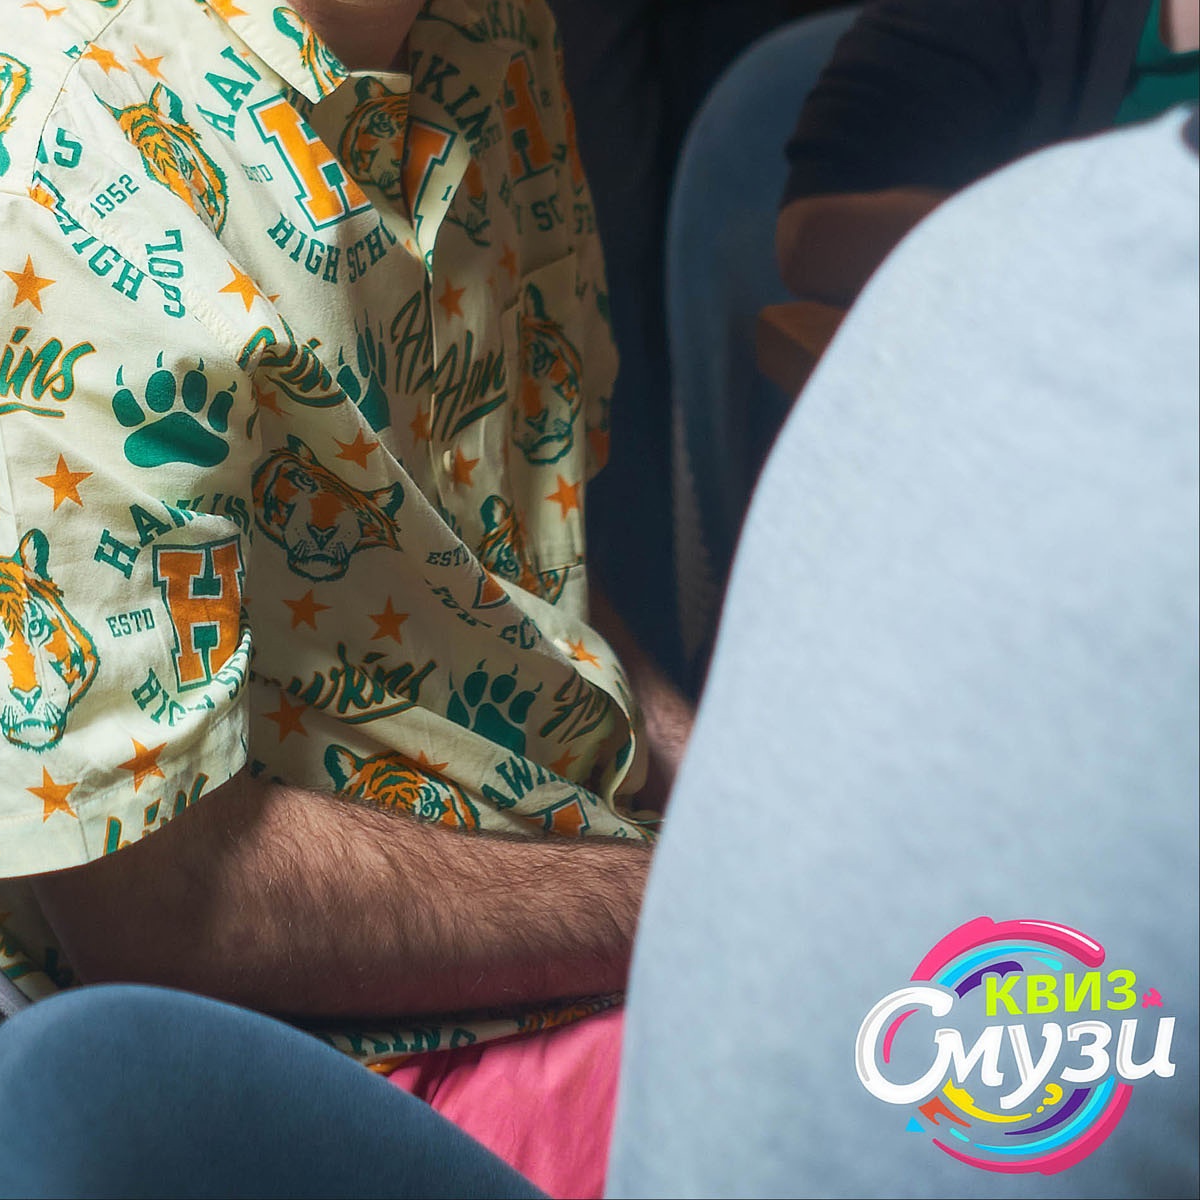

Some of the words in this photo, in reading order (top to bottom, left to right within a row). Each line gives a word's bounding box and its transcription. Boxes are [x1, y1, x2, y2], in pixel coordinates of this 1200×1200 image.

[89, 173, 140, 220] 1952
[267, 212, 339, 284] HIGH
[106, 607, 156, 638] ESTD
[152, 533, 247, 694] H
